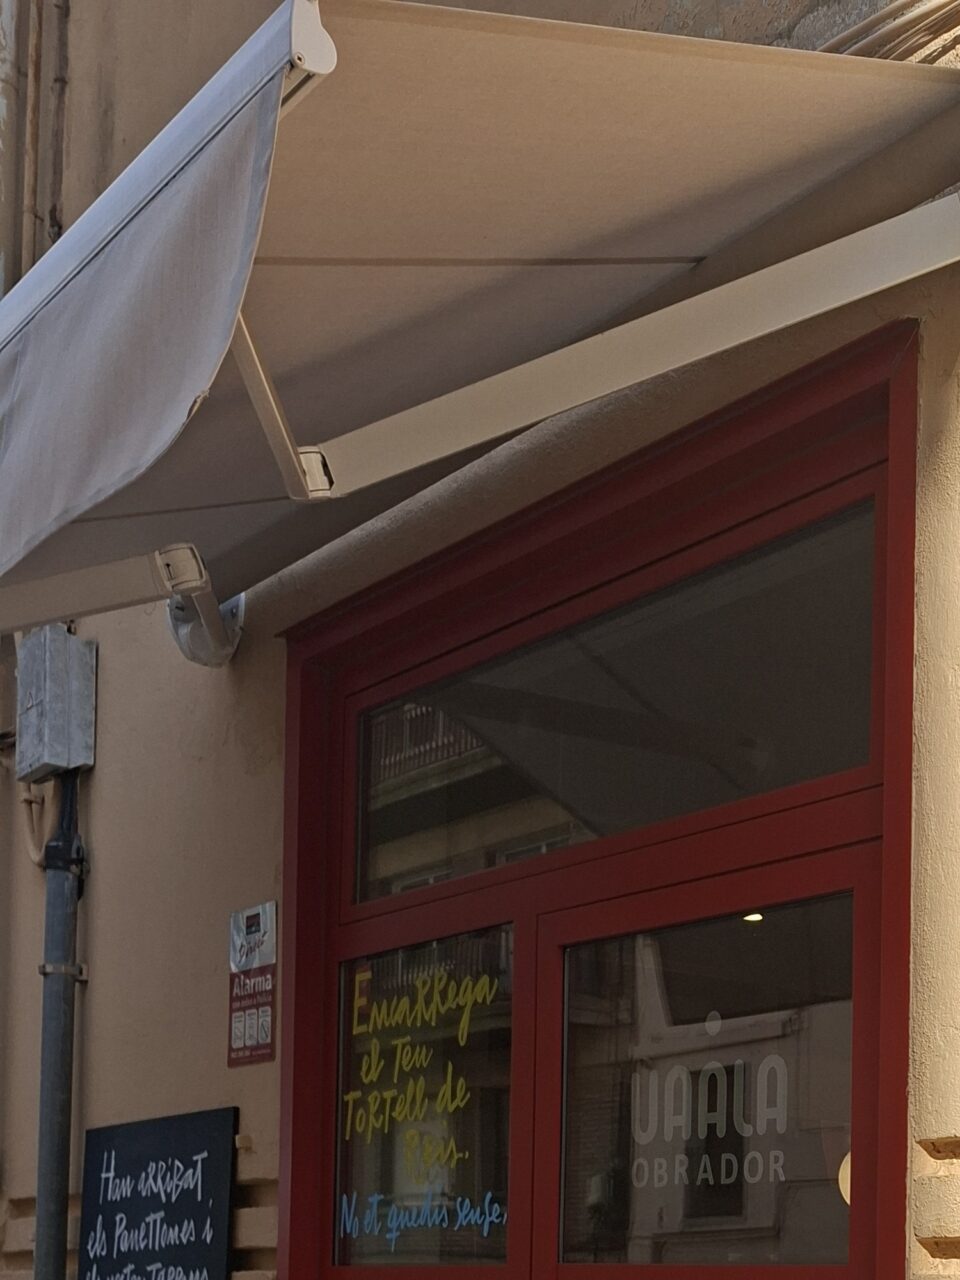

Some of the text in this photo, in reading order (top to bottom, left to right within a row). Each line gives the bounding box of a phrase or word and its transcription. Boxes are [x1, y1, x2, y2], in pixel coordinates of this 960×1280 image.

[232, 974, 272, 997] Alarma
[361, 1038, 384, 1084] el
[436, 1061, 471, 1113] de
[631, 1054, 788, 1145] UAALA
[100, 1150, 135, 1204] Han
[631, 1150, 786, 1188] OBRADOR
[87, 1214, 107, 1259] els
[202, 1198, 214, 1245] i
[341, 1192, 358, 1238] No
[365, 1192, 385, 1235] et
